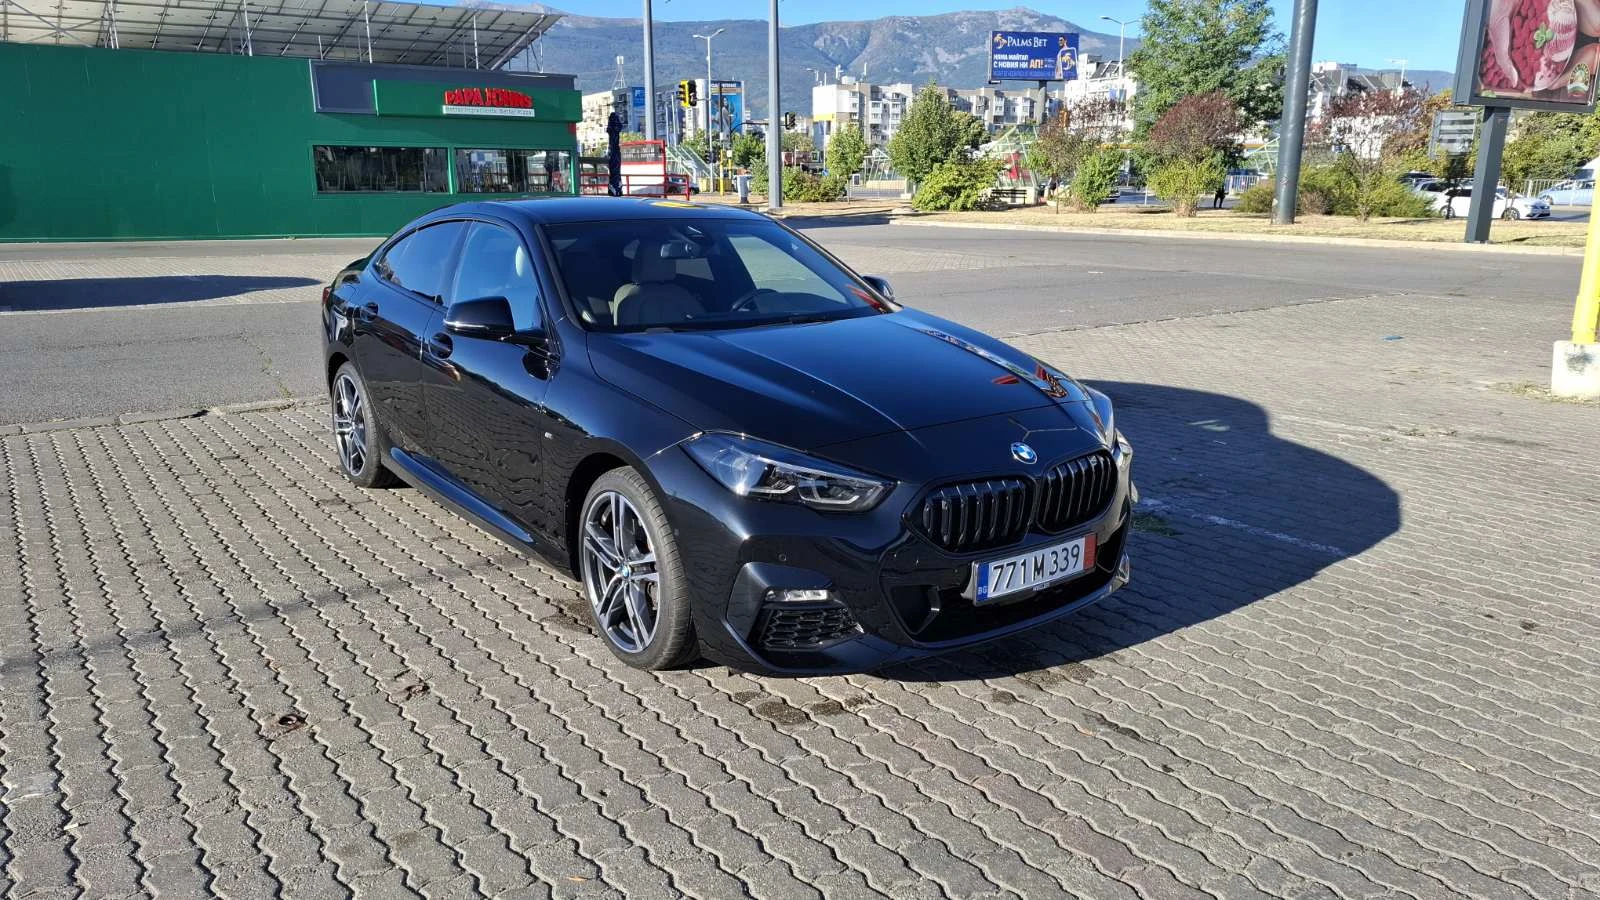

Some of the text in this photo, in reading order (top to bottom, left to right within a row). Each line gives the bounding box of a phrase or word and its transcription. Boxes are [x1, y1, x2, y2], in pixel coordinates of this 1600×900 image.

[1007, 36, 1048, 47] PALMS BET
[445, 87, 484, 105] PAPA
